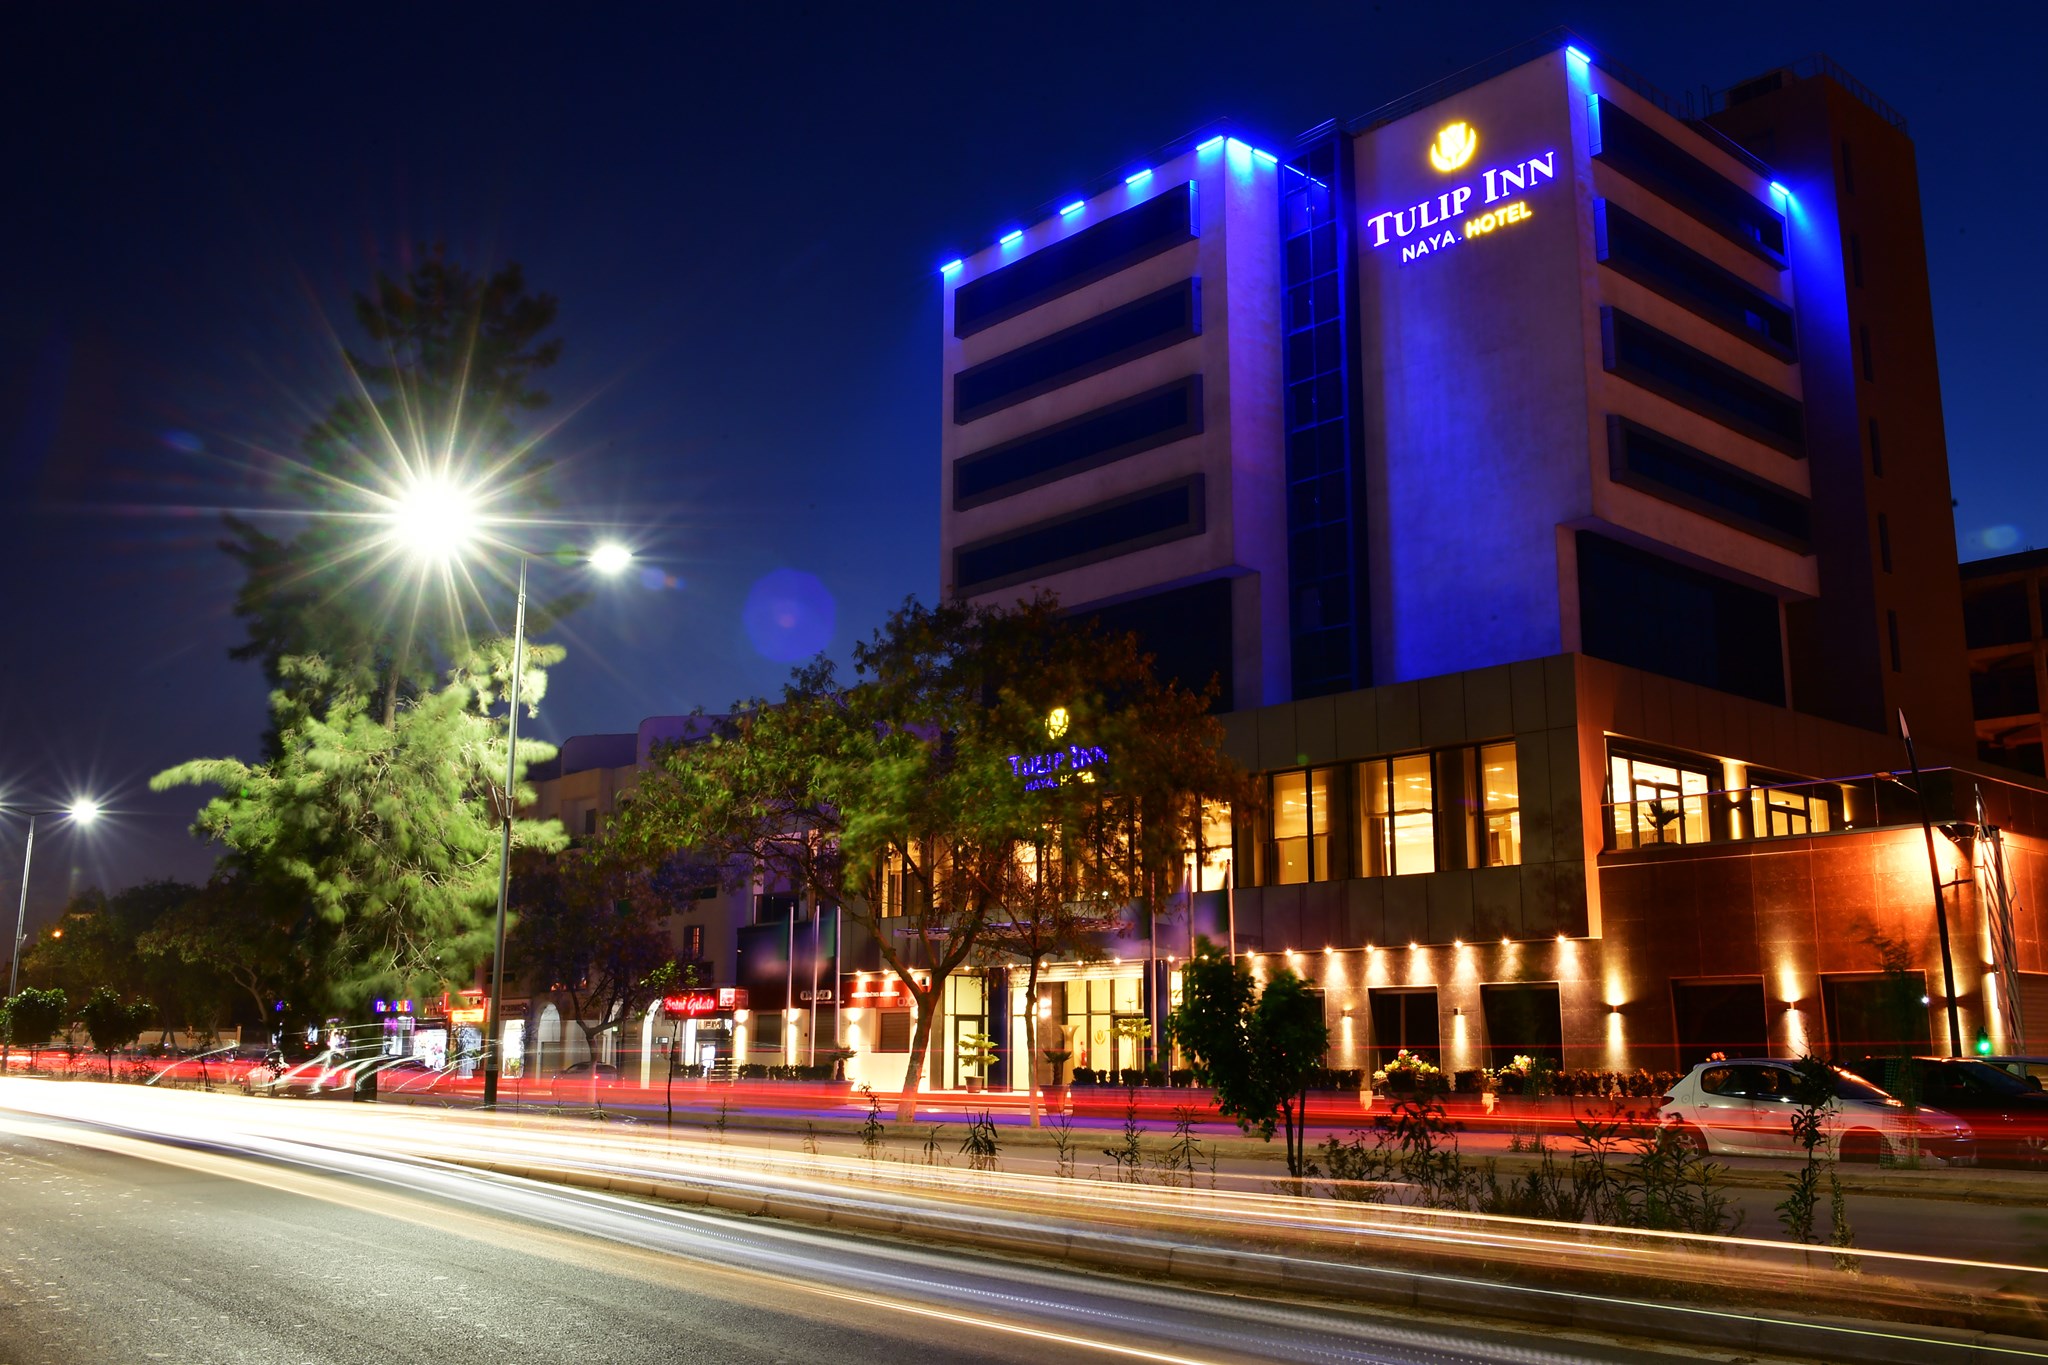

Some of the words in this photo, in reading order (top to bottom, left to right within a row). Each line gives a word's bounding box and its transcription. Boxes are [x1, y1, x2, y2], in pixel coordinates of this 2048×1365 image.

[1367, 186, 1471, 247] TULIP
[1482, 151, 1554, 204] INN
[1465, 201, 1532, 239] HOTEL
